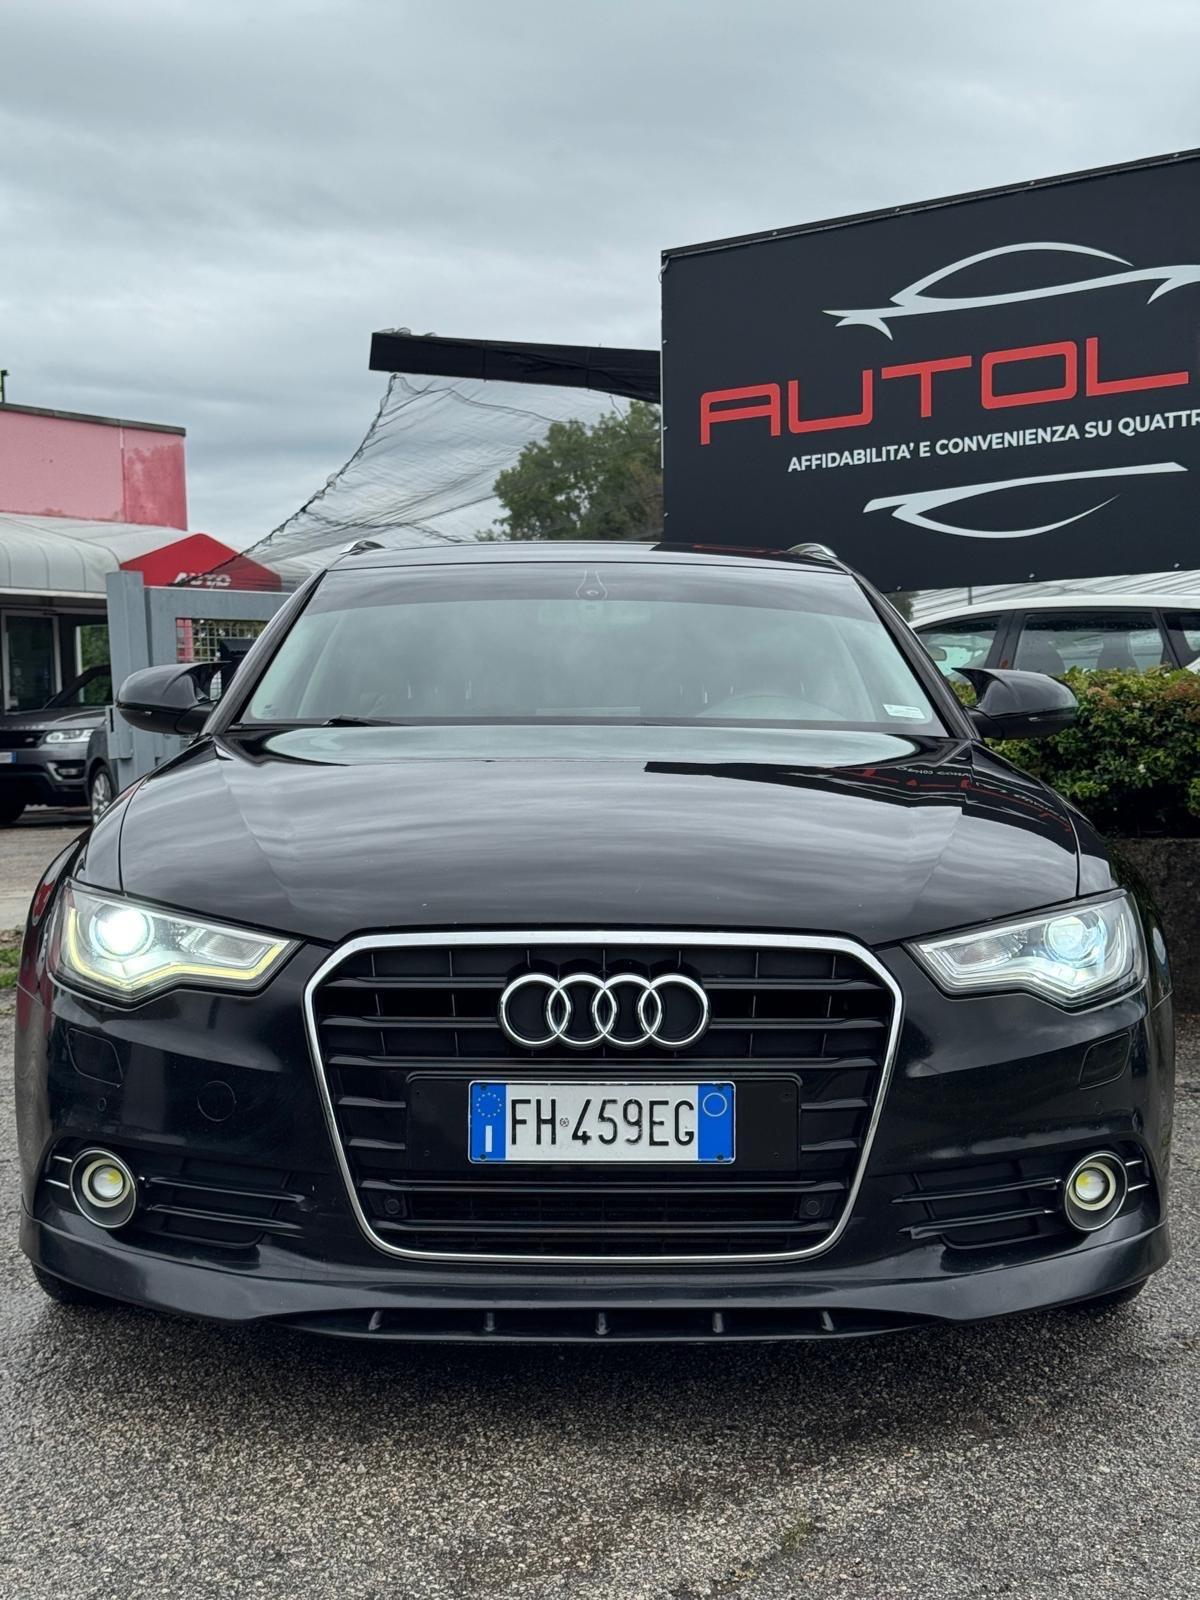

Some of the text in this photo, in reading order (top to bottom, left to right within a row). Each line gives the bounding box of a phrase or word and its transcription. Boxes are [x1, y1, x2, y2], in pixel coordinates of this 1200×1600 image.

[700, 337, 1189, 445] AUTOL
[919, 440, 931, 458] E
[935, 423, 1081, 456] CONVENIENZA
[1084, 419, 1113, 439] SU
